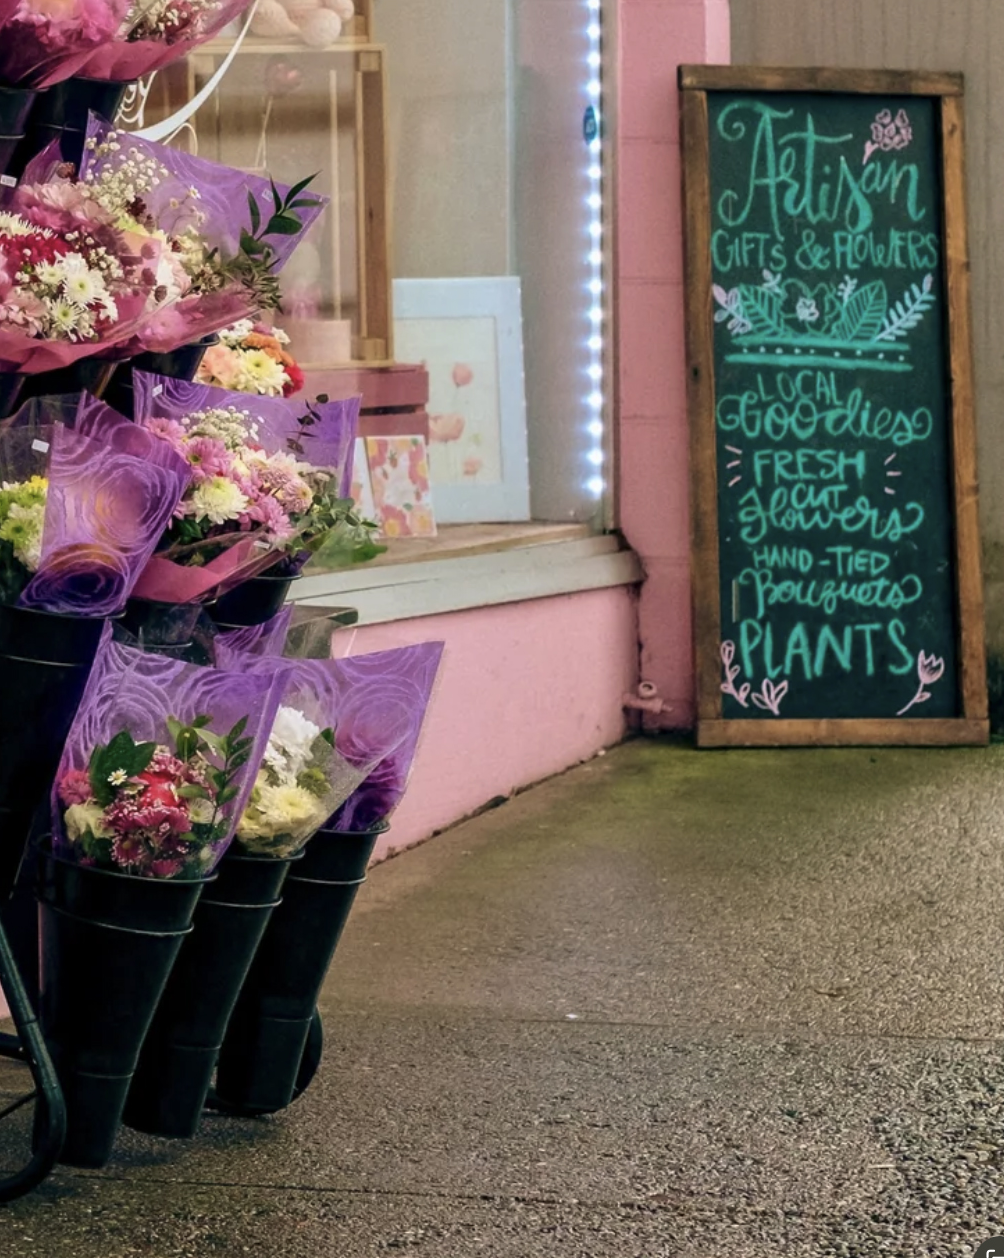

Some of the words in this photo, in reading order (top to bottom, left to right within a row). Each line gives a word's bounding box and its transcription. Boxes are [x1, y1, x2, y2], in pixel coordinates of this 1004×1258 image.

[717, 100, 926, 241] Artisan
[795, 228, 832, 270] &
[757, 369, 844, 405] LOCAL
[716, 387, 933, 446] Goodies
[752, 448, 866, 486] FRESH
[739, 618, 915, 681] PLANTS
